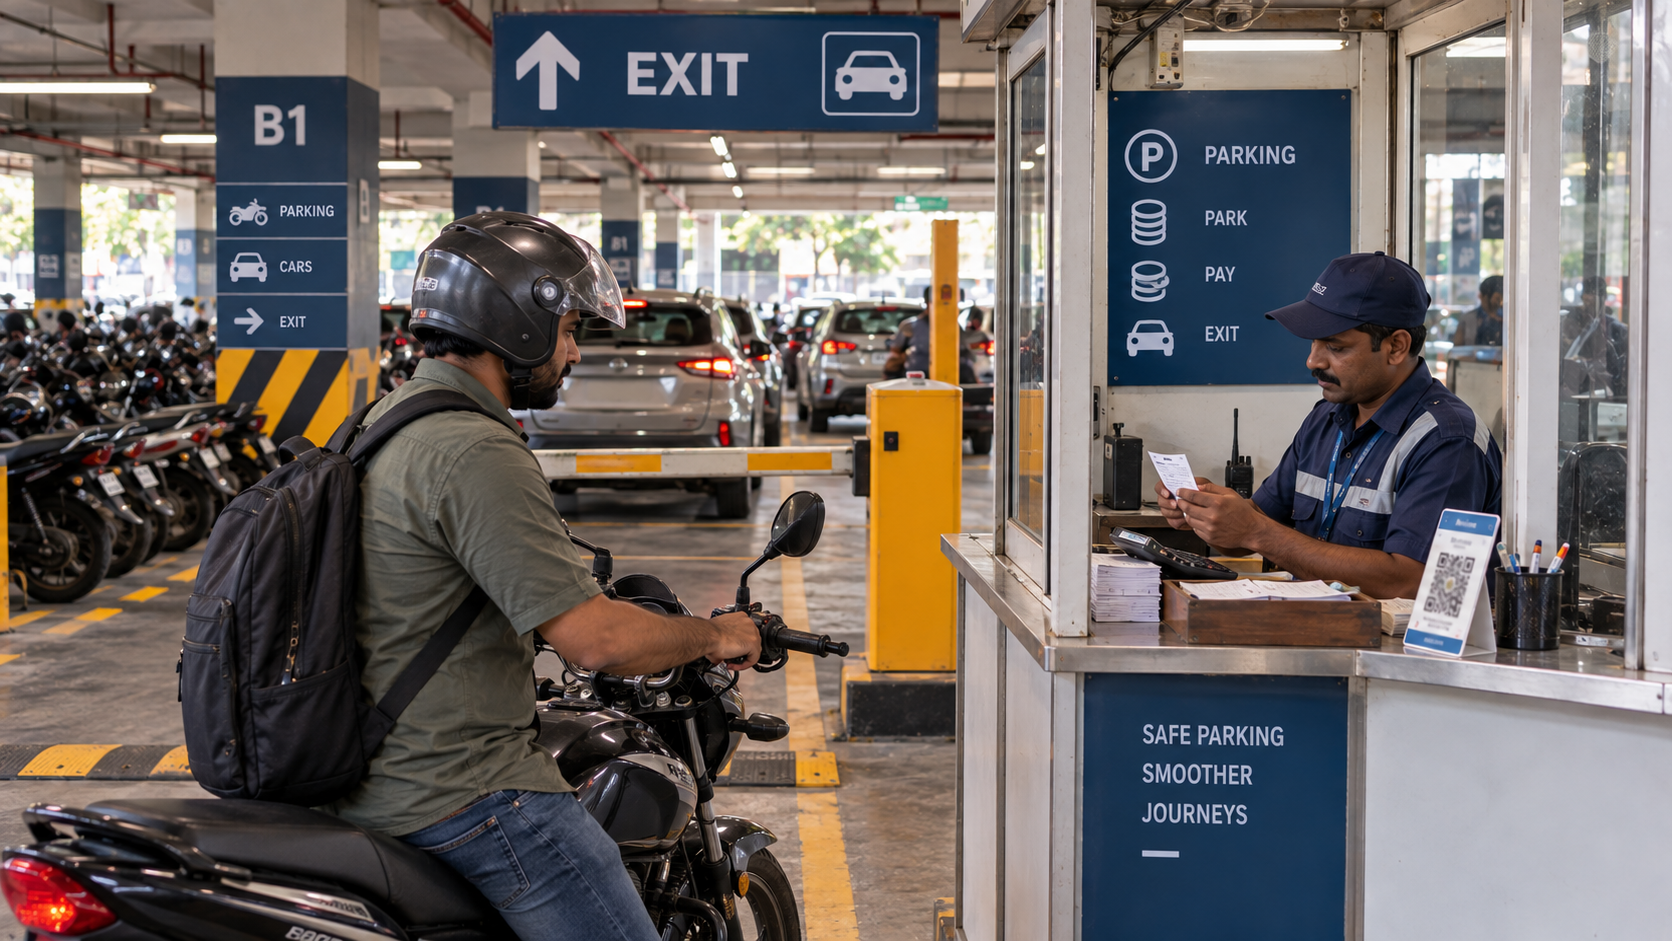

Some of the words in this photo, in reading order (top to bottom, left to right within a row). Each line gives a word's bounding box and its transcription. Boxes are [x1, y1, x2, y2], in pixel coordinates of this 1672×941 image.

[628, 51, 749, 96] EXIT
[253, 104, 306, 146] B1
[1141, 142, 1164, 172] P
[1205, 145, 1296, 165] PARKING
[279, 204, 335, 218] PARKING
[1205, 210, 1248, 226] PARK
[279, 260, 313, 273] CARS
[1205, 266, 1236, 282] PAY
[279, 315, 307, 328] EXIT
[1205, 325, 1240, 342] EXIT
[1142, 723, 1191, 746] SAFE
[1197, 725, 1284, 747] PARKING
[1142, 762, 1253, 785] SMOOTHER
[1141, 802, 1248, 825] JOURNEYS
